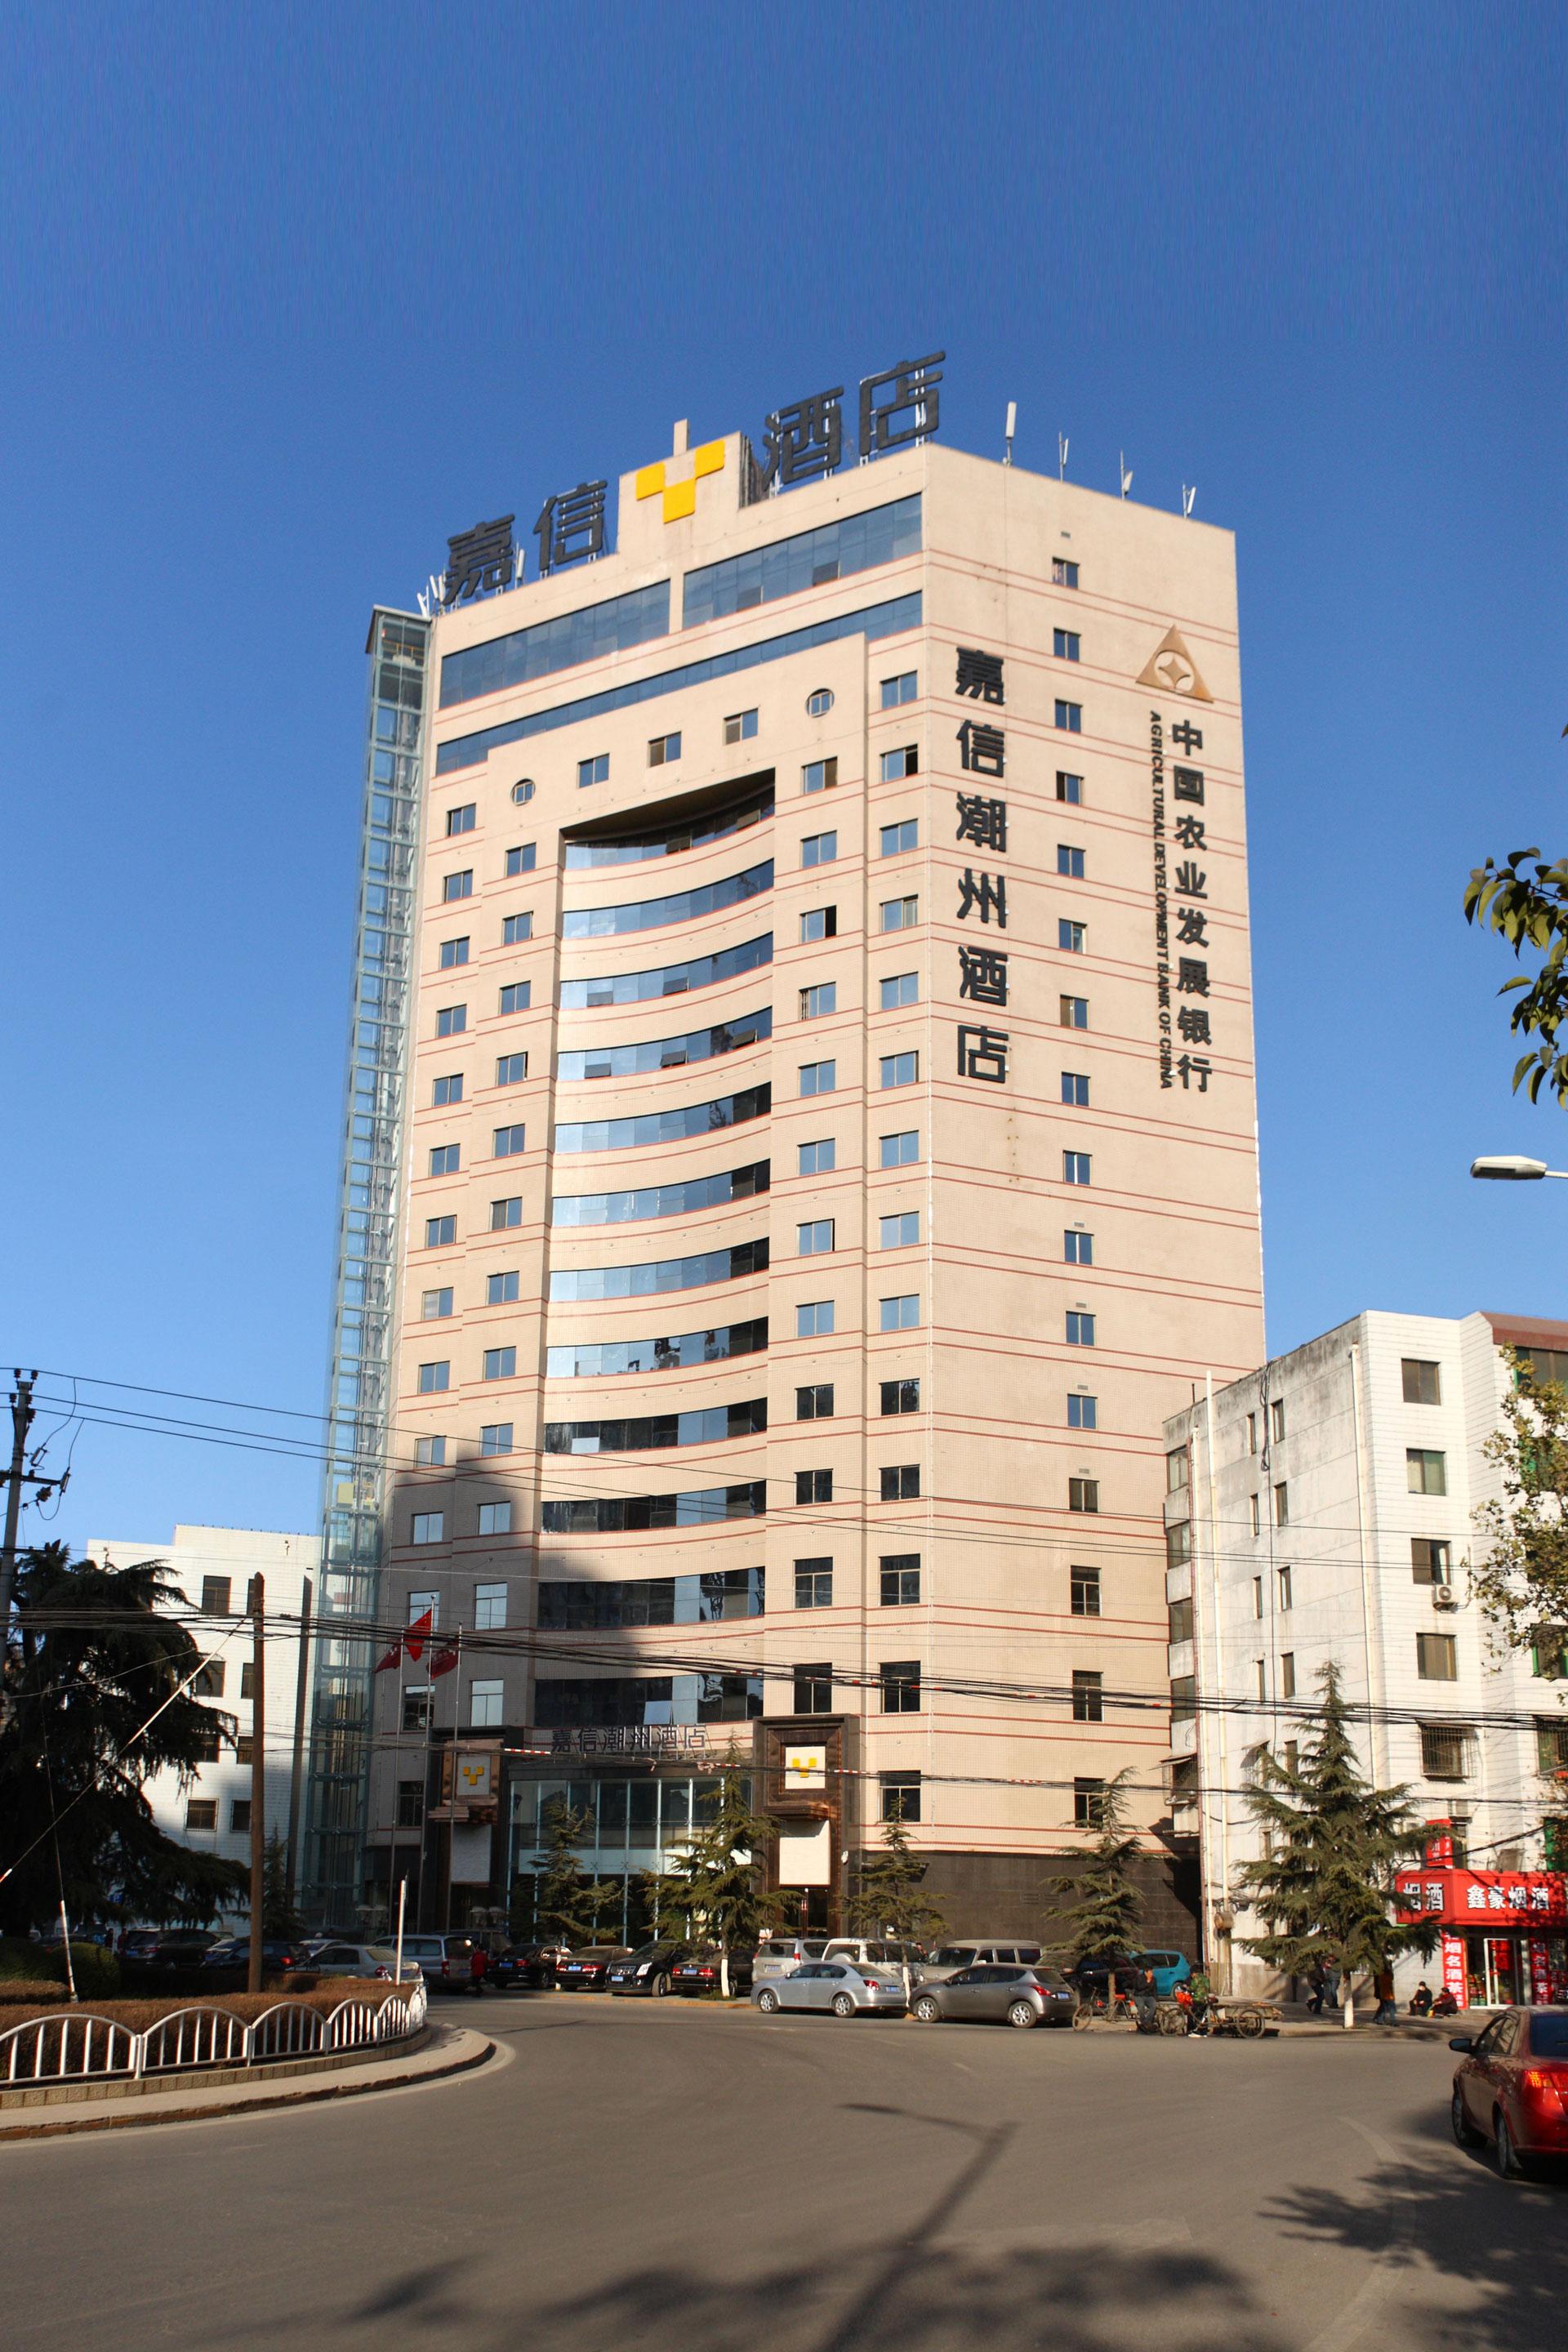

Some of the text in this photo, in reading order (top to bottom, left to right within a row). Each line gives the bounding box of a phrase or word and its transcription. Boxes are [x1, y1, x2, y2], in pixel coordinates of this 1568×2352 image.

[442, 350, 945, 605] 嘉信 酒店
[956, 647, 1009, 1085] 嘉信潮州酒店
[1151, 710, 1173, 1089] AGRICULTURAL DEVELOPMENT BANK OF CHINA
[1172, 719, 1213, 1093] 中国农业发展银行
[551, 1723, 706, 1753] 嘉信潮州酒店
[1467, 1884, 1550, 1910] 鑫豪烟酒
